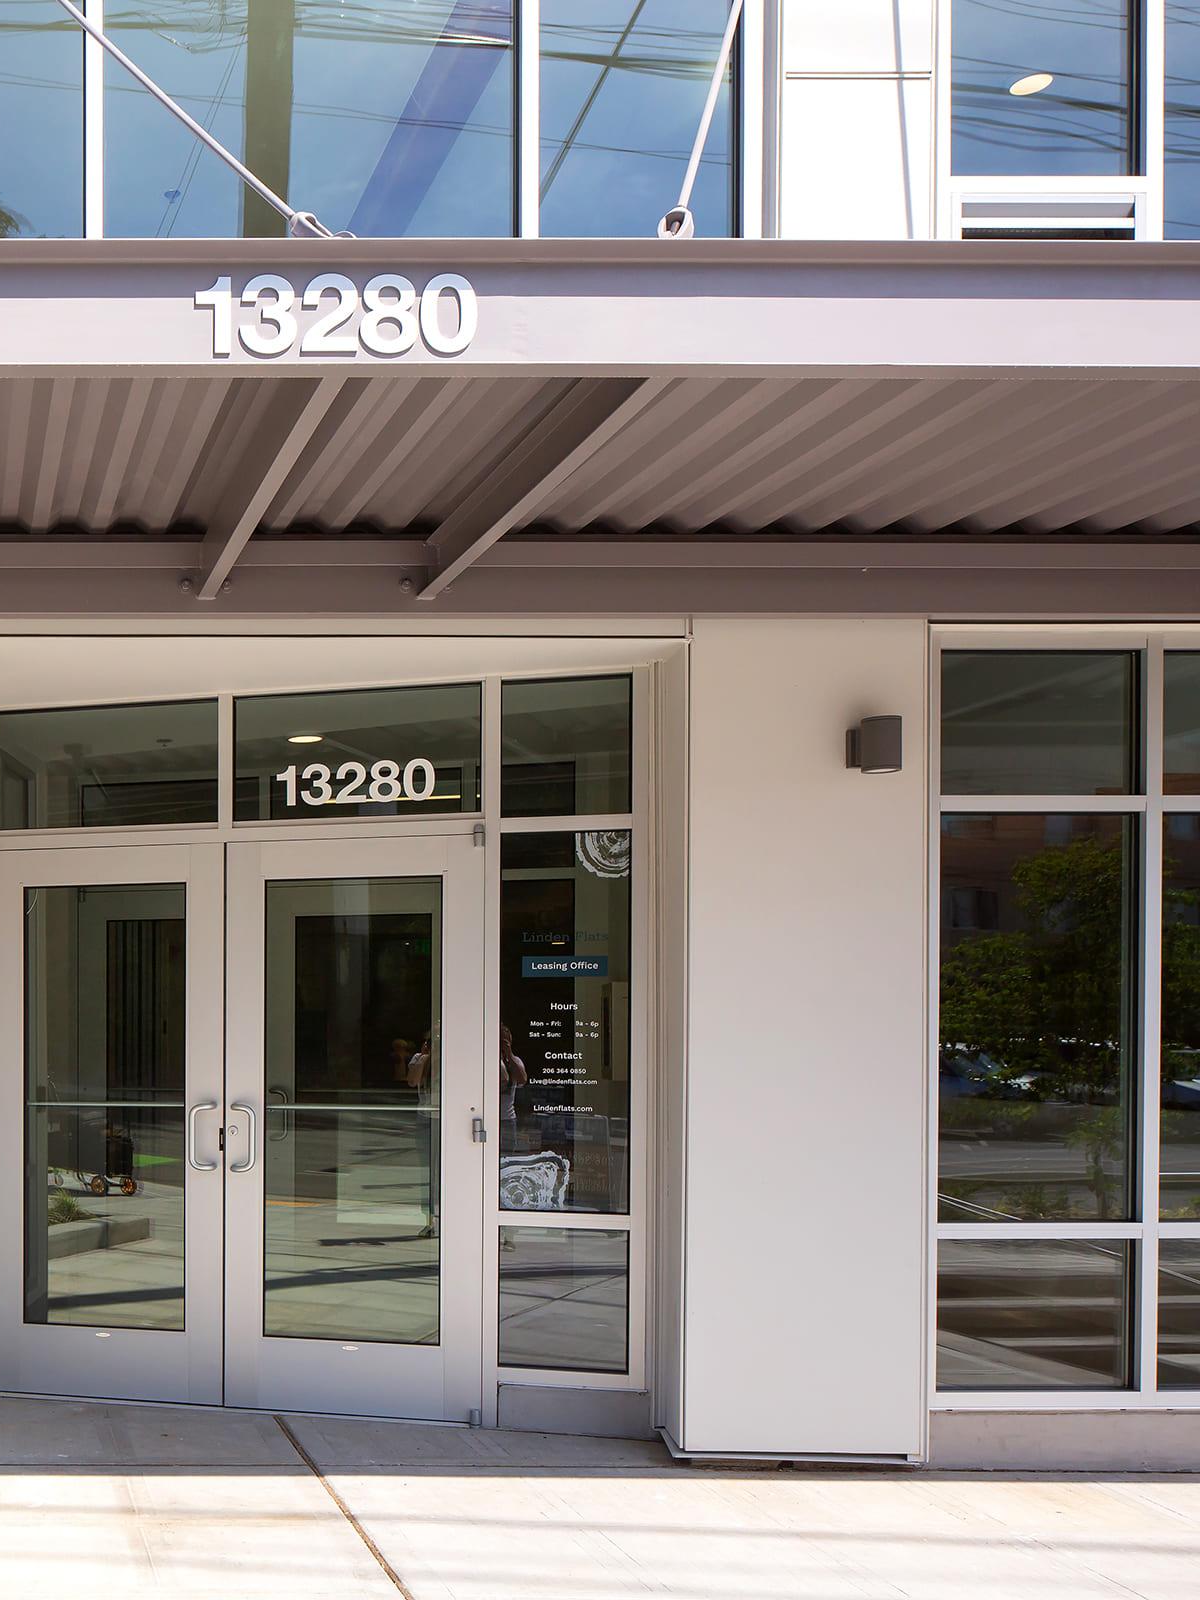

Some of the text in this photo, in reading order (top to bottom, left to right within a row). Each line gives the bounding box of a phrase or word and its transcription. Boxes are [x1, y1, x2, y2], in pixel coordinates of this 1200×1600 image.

[194, 272, 478, 358] 13280
[276, 758, 436, 807] 13280
[522, 931, 570, 943] Linden
[531, 961, 599, 972] Leasing Office
[550, 1002, 578, 1011] Hours
[590, 1020, 599, 1028] 6p
[590, 1031, 599, 1039] 6p
[544, 1051, 583, 1060] Contact
[542, 1067, 555, 1075] 206
[533, 1104, 593, 1112] Lindenflats.com
